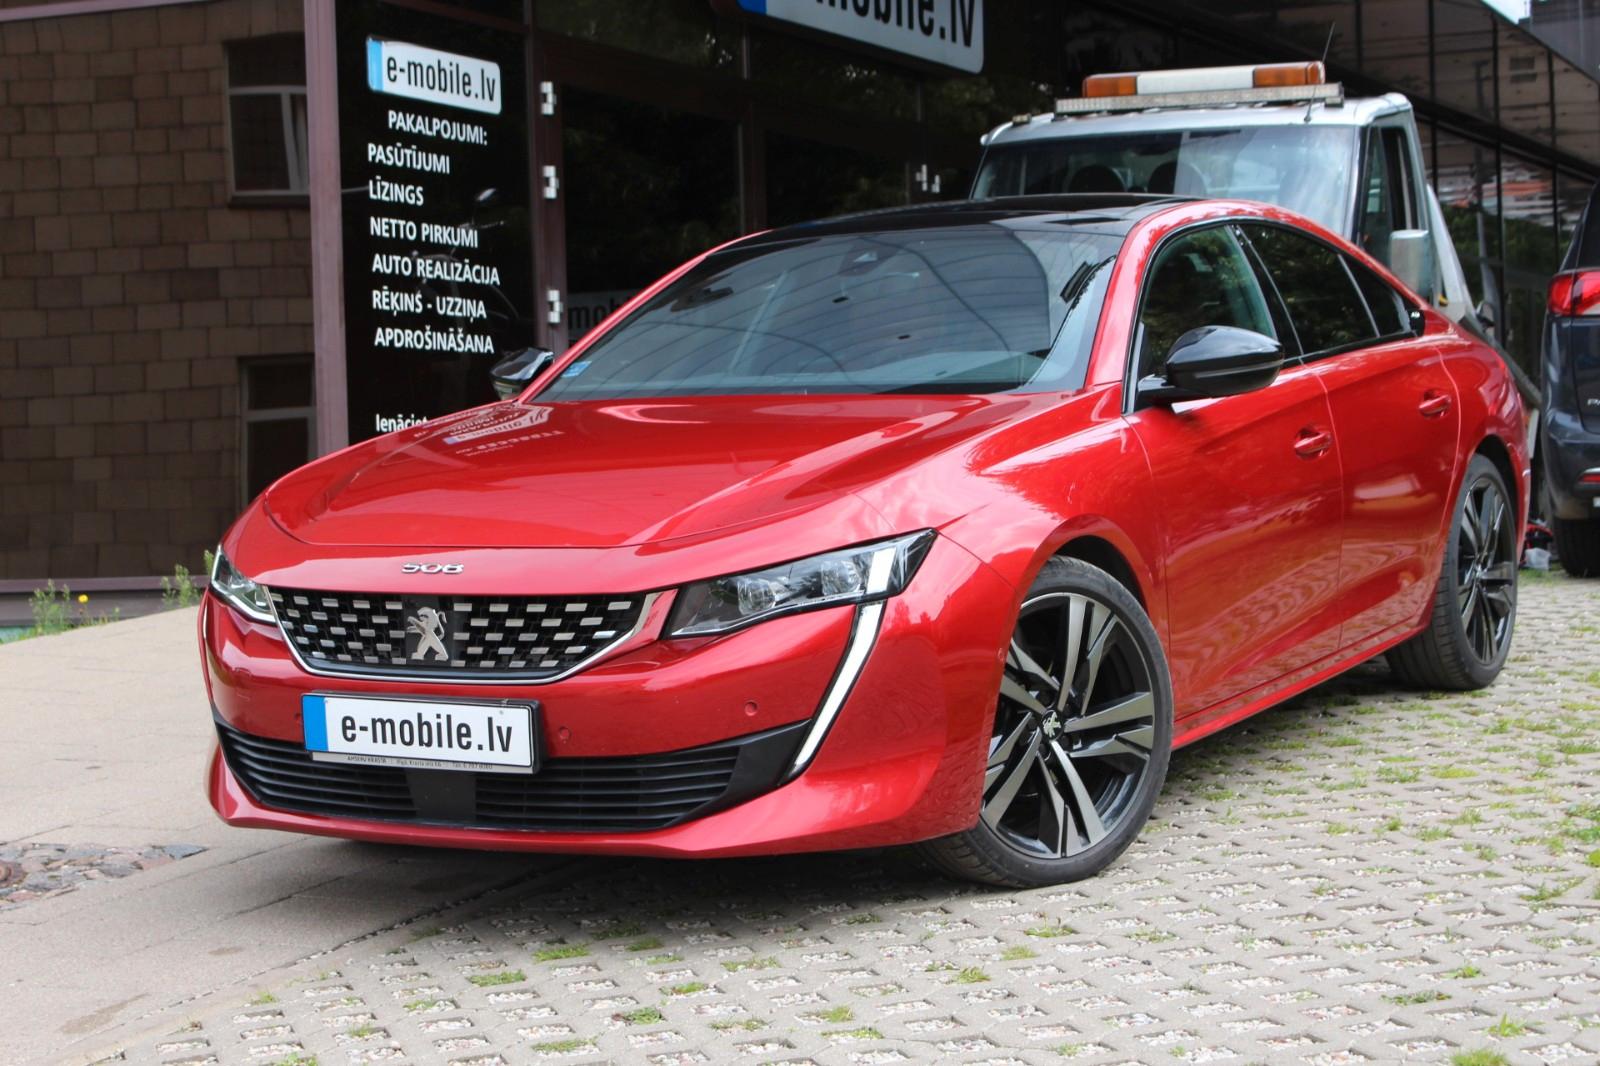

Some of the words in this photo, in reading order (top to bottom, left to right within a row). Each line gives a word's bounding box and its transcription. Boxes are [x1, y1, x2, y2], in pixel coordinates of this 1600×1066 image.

[387, 56, 496, 101] e-mobile.lv
[388, 109, 488, 146] PAKALPOJUMI:
[368, 142, 450, 174] PASŪTĪJUMI
[368, 175, 424, 206] LĪZINGS
[370, 216, 417, 240] NETTO
[421, 222, 479, 248] PIRKUMI
[372, 253, 412, 276] AUTO
[416, 258, 500, 286] REALIZĀCIJA
[436, 296, 487, 323] UZZIŅA
[374, 325, 495, 354] APDROŠINĀŠANA
[401, 562, 464, 575] 508
[341, 712, 512, 752] e-mobile.lv
